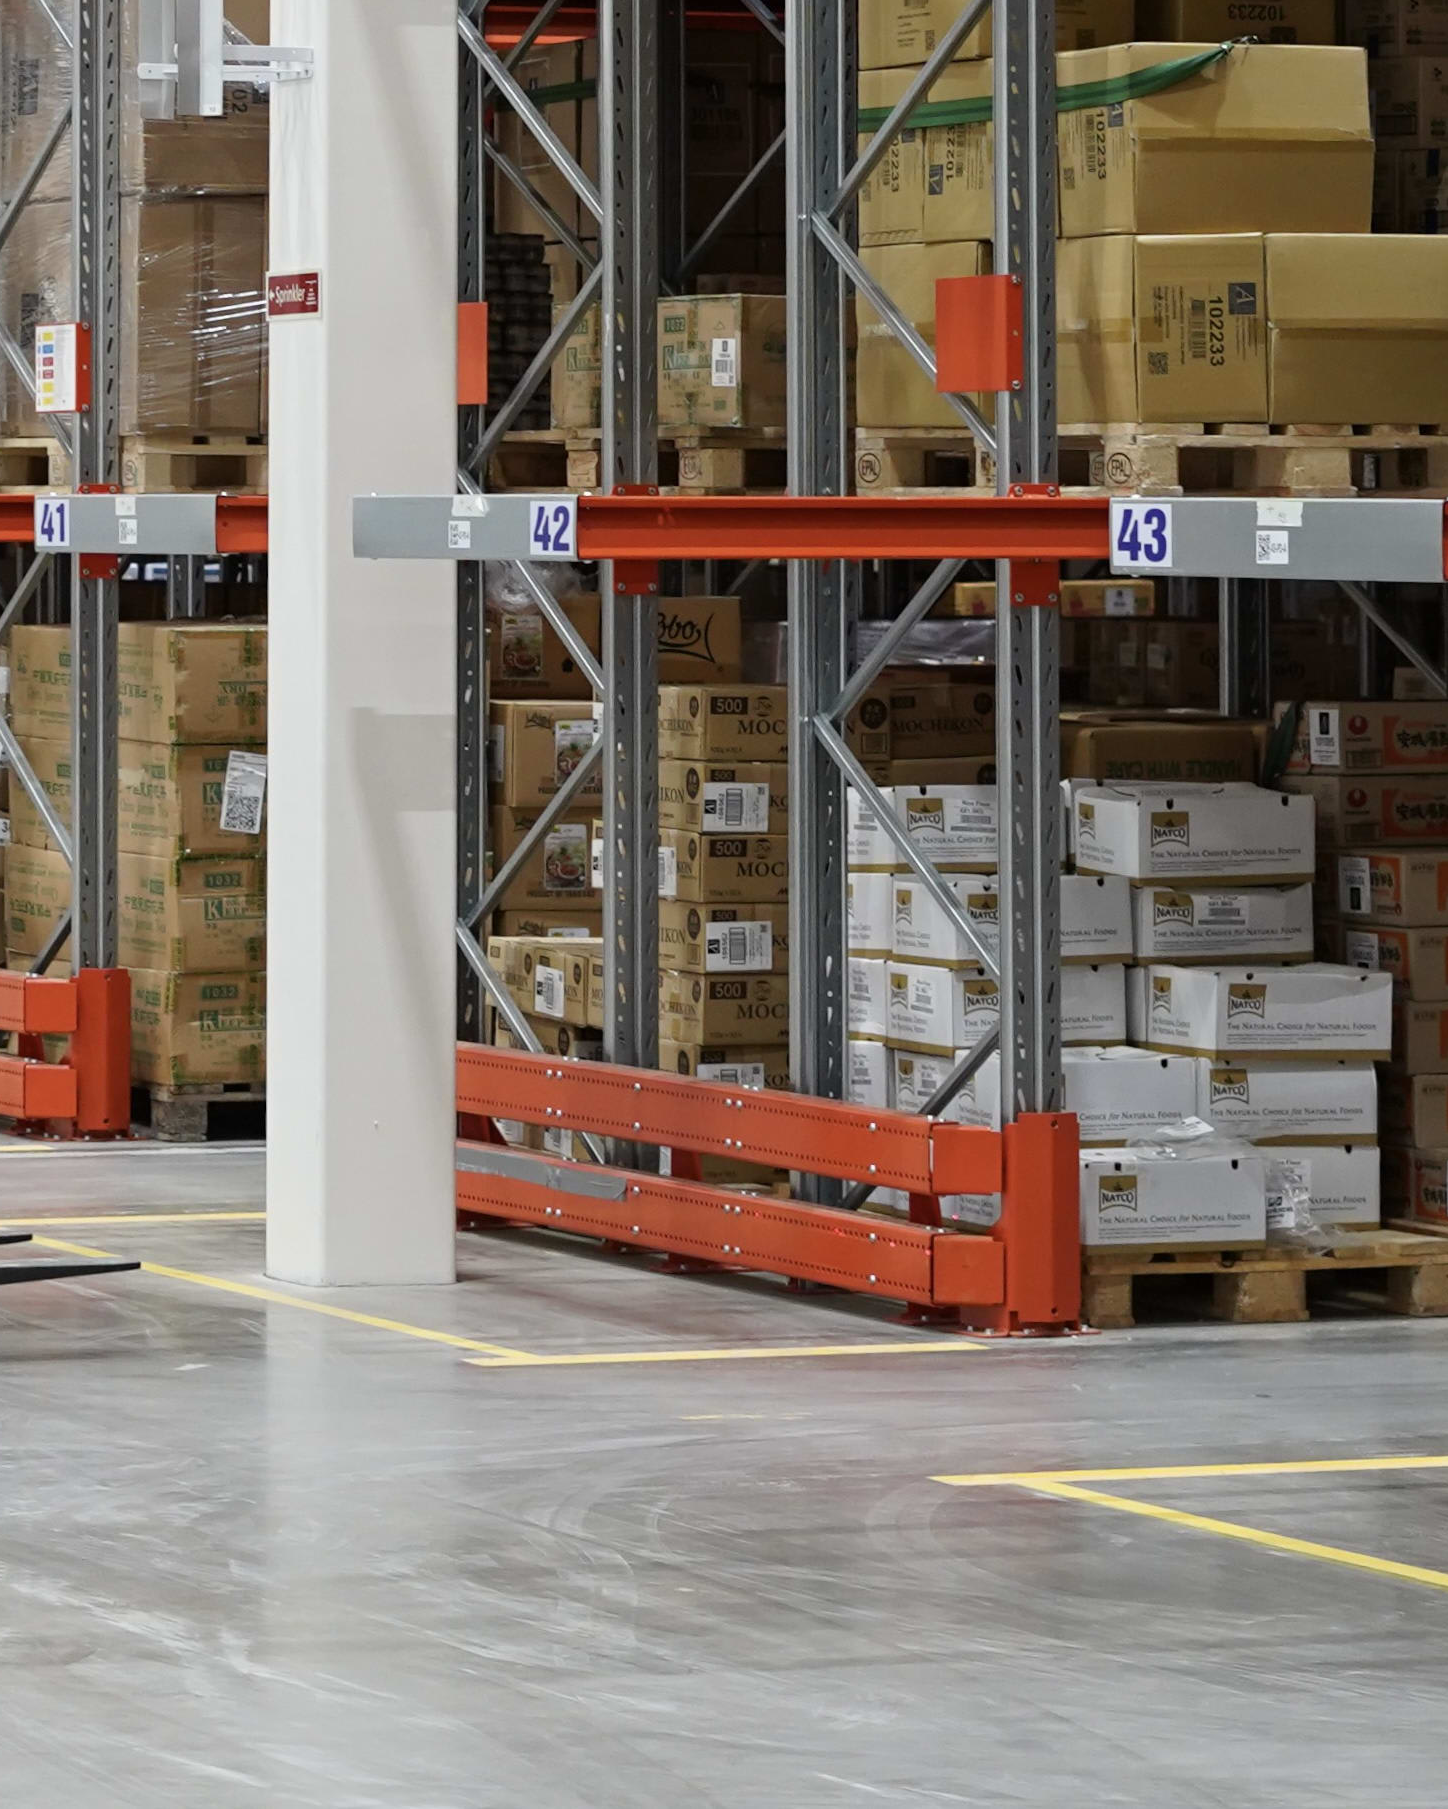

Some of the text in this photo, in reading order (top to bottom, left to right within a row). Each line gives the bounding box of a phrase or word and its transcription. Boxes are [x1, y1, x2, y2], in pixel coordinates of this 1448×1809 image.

[1227, 4, 1285, 22] 102233
[1095, 108, 1107, 180] 102233
[275, 283, 306, 307] Sprinkler
[1209, 295, 1224, 367] 102233
[41, 503, 65, 542] 41
[534, 505, 570, 551] 42
[1117, 508, 1167, 561] 43
[716, 698, 743, 714] 500
[909, 812, 941, 826] NATCO
[1153, 826, 1186, 839] NATCO
[715, 841, 743, 856] 500
[1156, 906, 1190, 918] NATCO
[715, 983, 742, 998] 500
[1230, 998, 1261, 1011] NATCO
[1212, 1085, 1246, 1097] NATCO
[1102, 1192, 1134, 1204] NATCO
